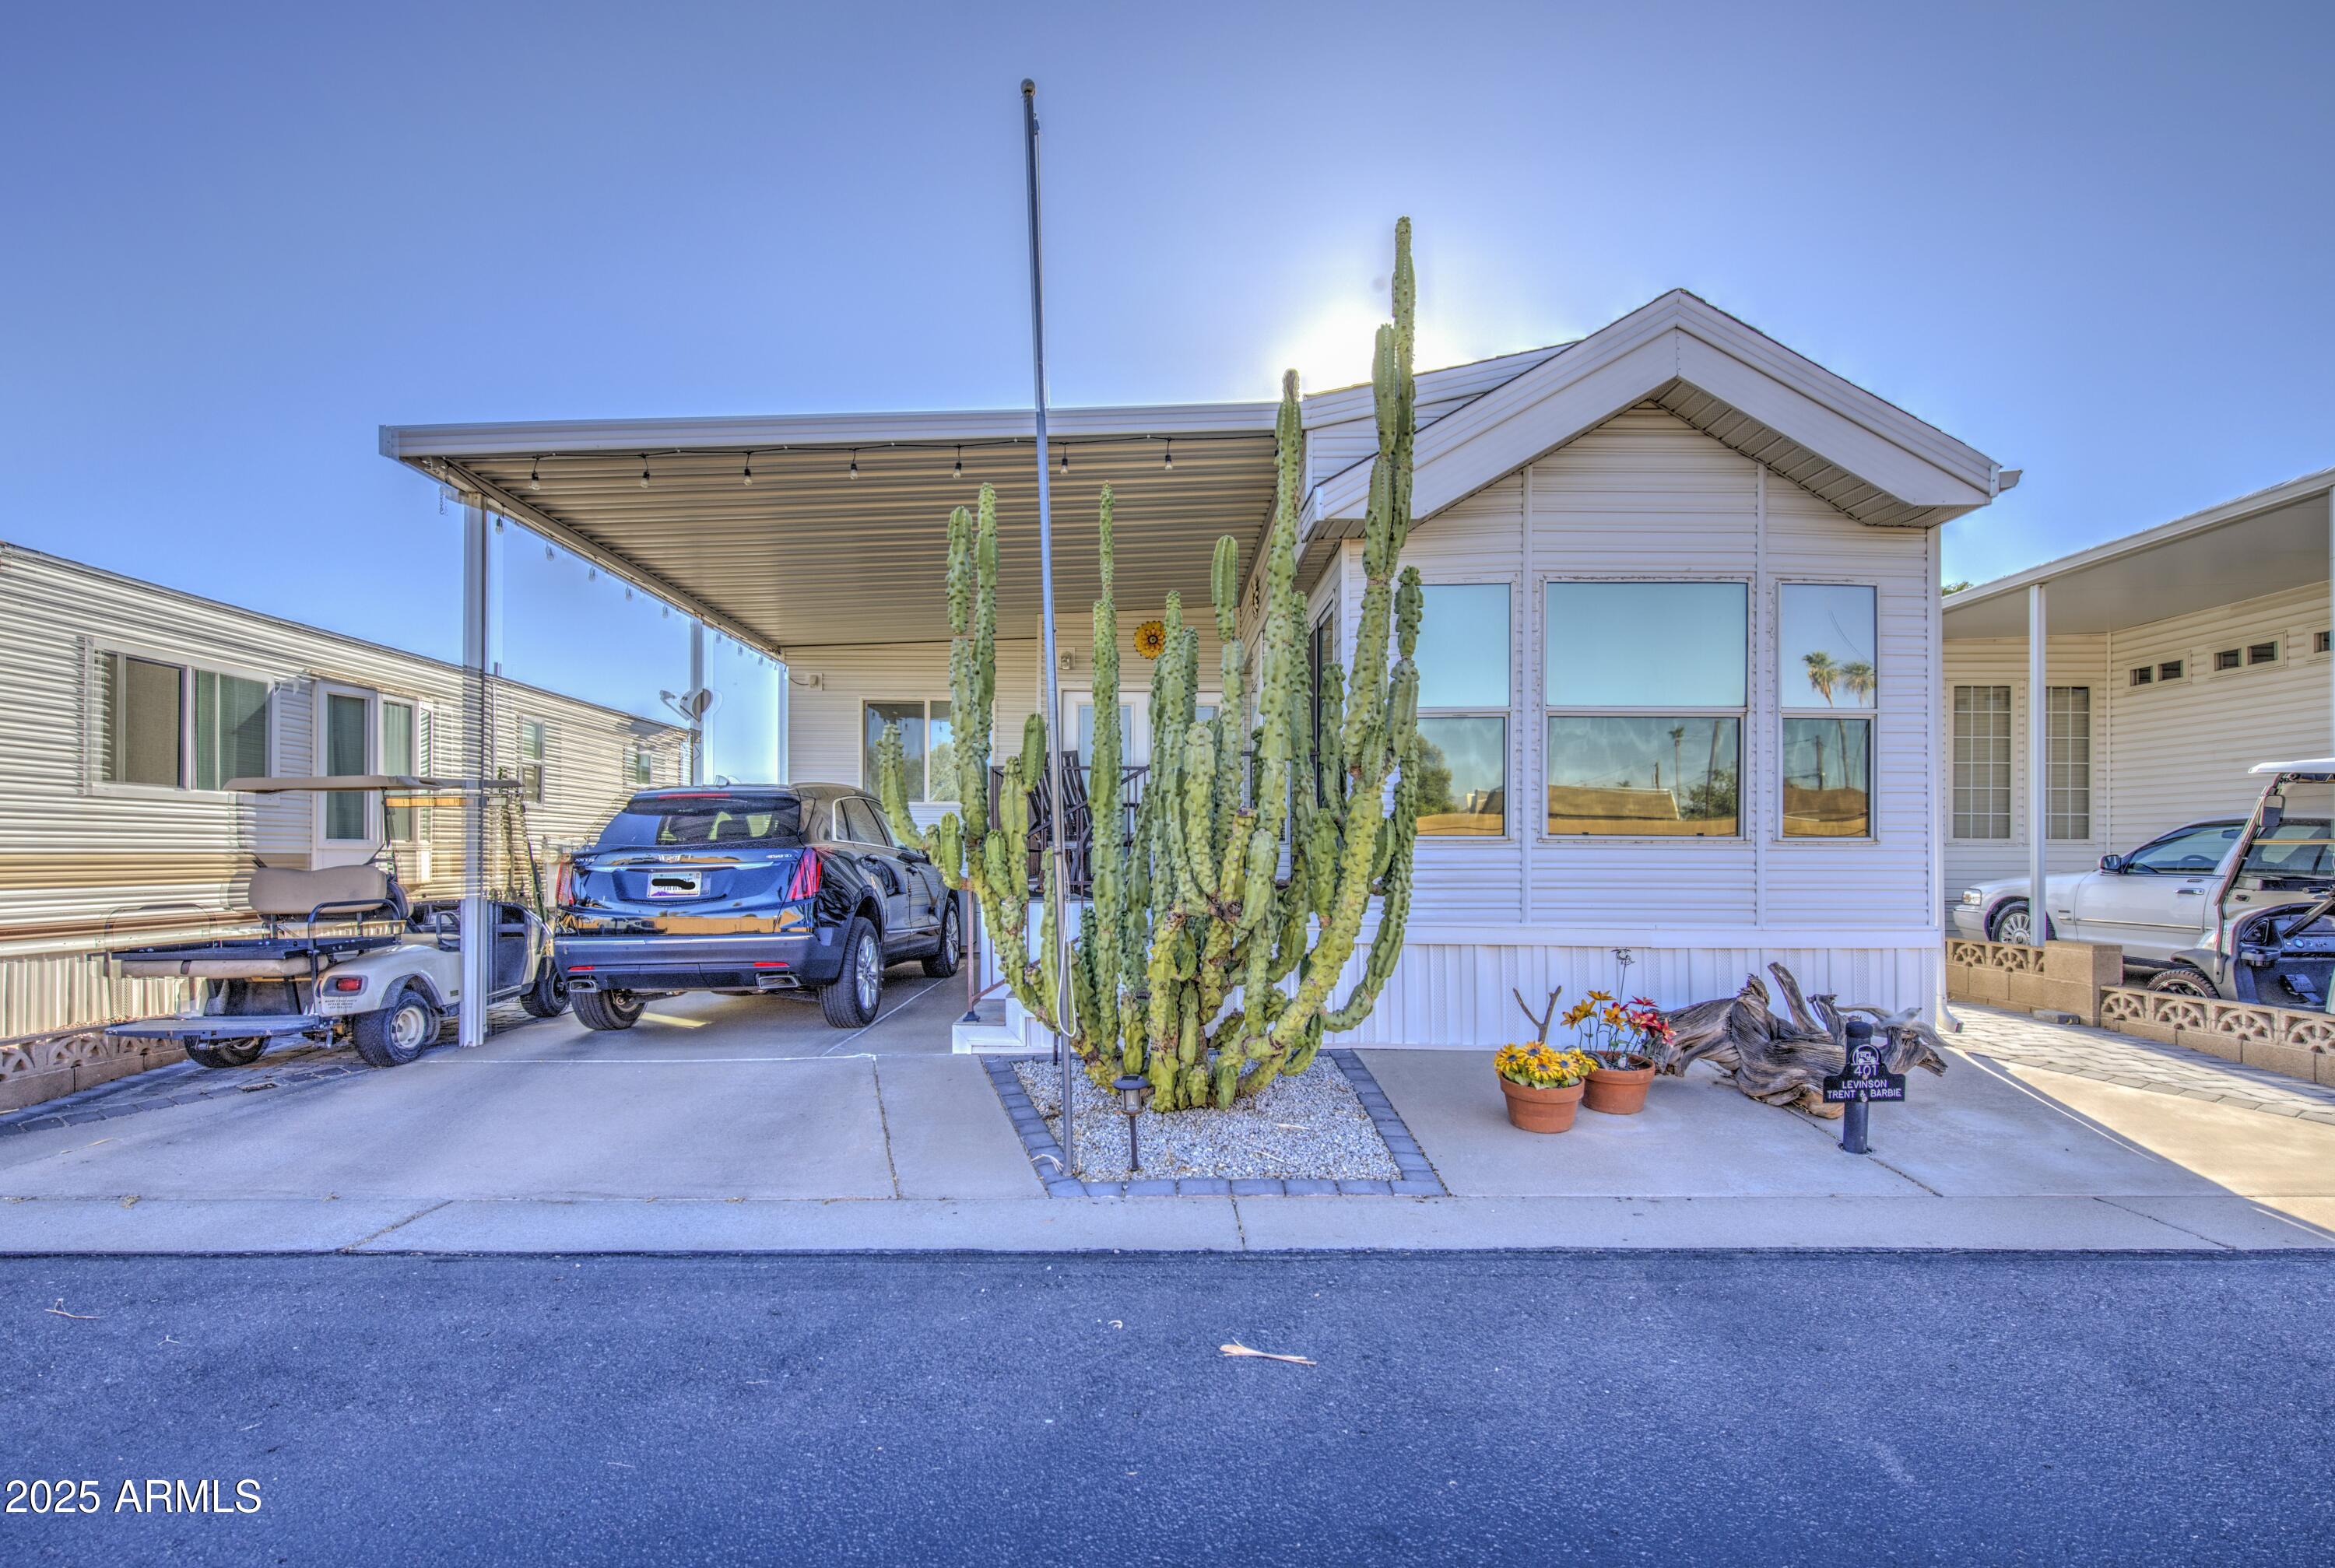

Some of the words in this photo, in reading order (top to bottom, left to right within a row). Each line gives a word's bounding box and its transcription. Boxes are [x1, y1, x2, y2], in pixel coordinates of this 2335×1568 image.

[1854, 1065, 1878, 1076] 401
[1842, 1079, 1887, 1089] LEVINSON
[1827, 1090, 1856, 1099] TRENT
[1870, 1089, 1901, 1098] BARBIE
